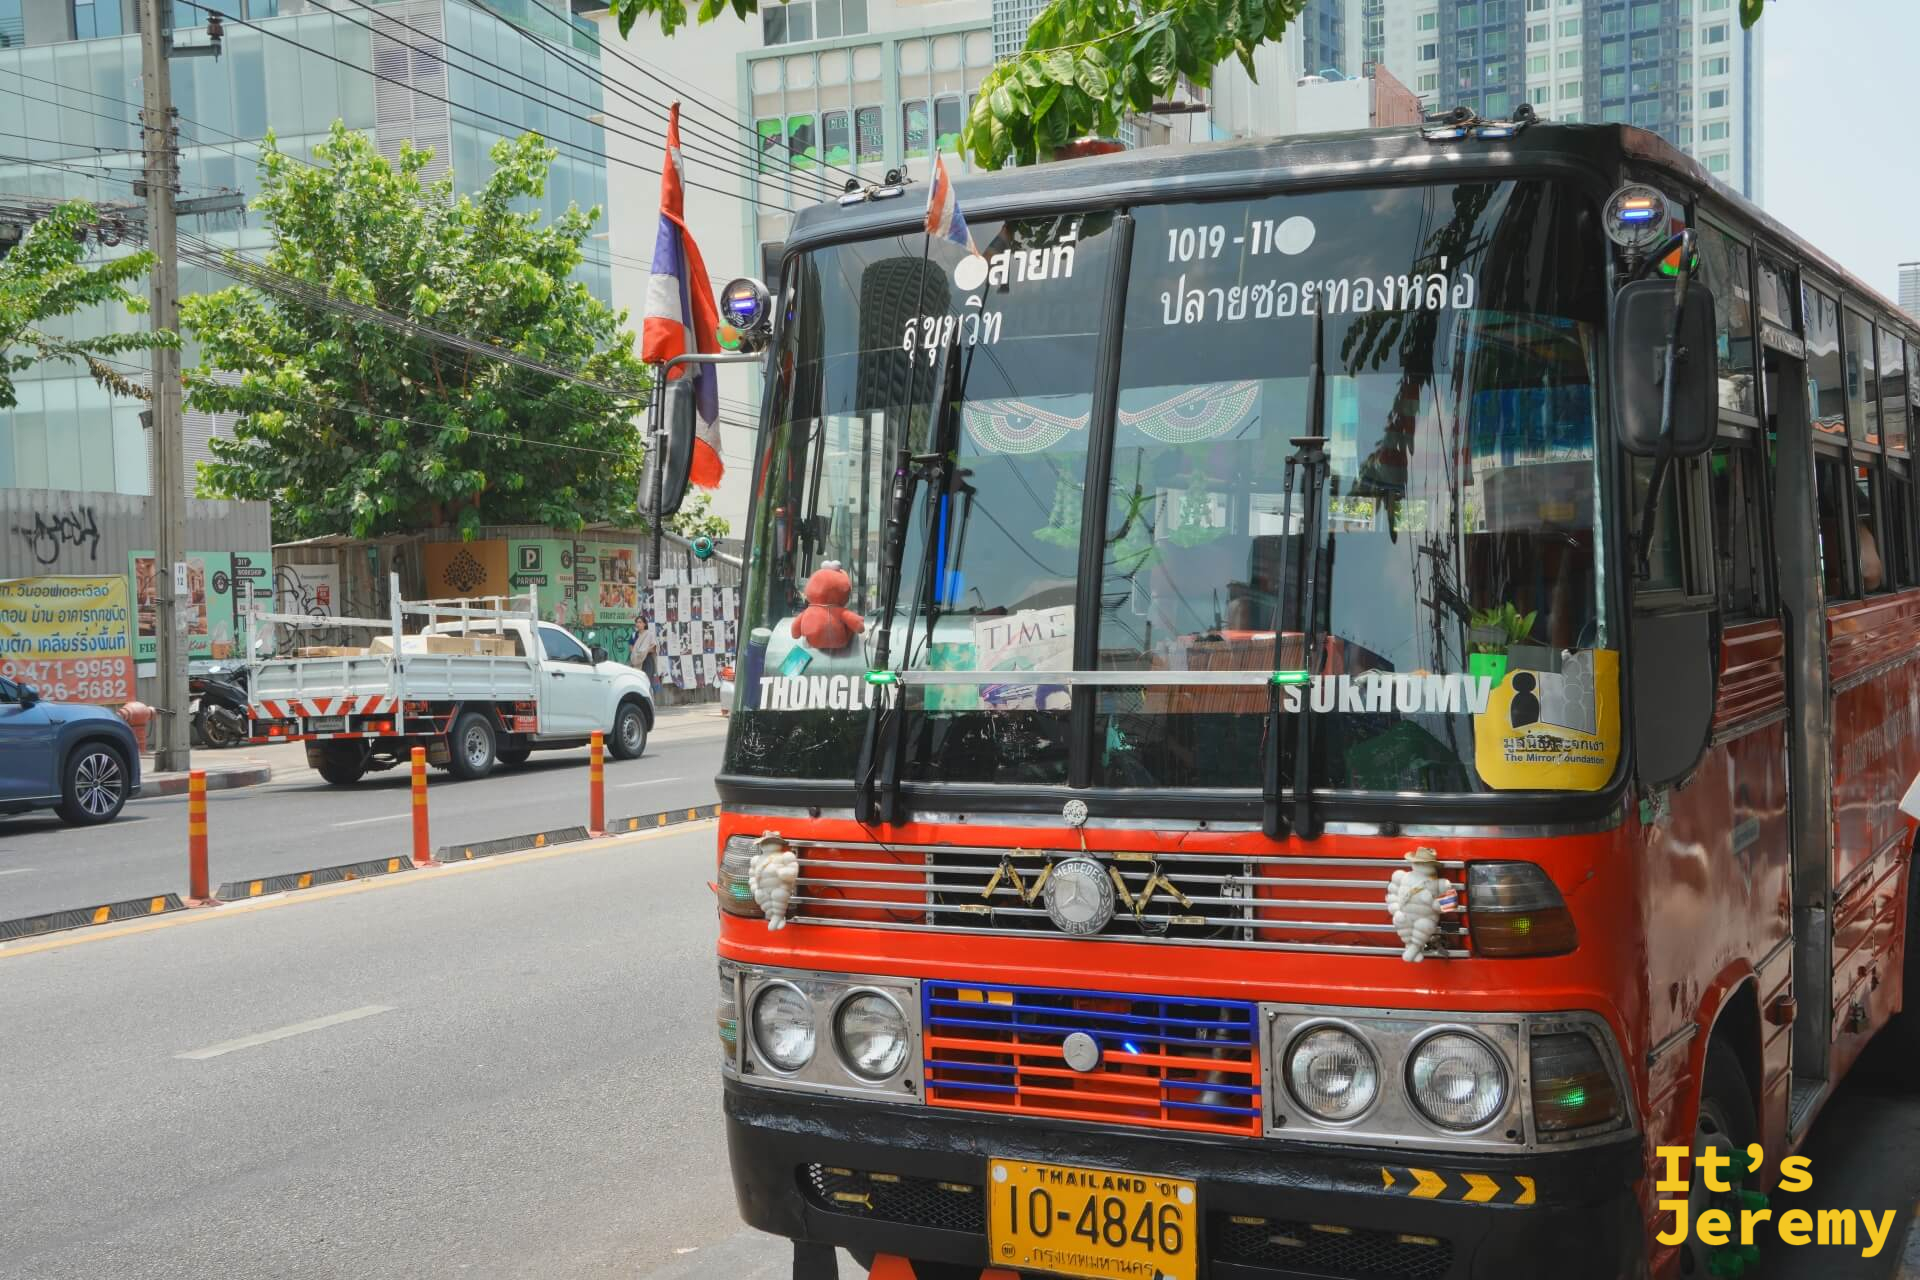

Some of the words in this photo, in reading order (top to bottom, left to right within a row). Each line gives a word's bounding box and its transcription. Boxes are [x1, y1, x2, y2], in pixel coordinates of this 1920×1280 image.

[988, 222, 1076, 286] สายที่
[1161, 256, 1475, 325] ปลายซอยทองหล่อ
[903, 295, 1003, 368] สุขุมวิท
[238, 569, 263, 577] WORKSHOP
[516, 575, 546, 585] PARKING
[32, 603, 53, 623] บ้าน
[983, 613, 1067, 649] TIME
[35, 680, 127, 700] 26-5682
[1504, 729, 1604, 752] มูลนิธิะจกเงา
[1505, 753, 1522, 762] The
[1526, 753, 1556, 763] Mirror
[1052, 862, 1103, 884] MERCEDES
[1065, 920, 1094, 933] BENZ
[1037, 1167, 1148, 1194] THAILAND
[1010, 1185, 1183, 1256] 10-4846
[1032, 1247, 1153, 1276] กรุงเทพมหานคร
